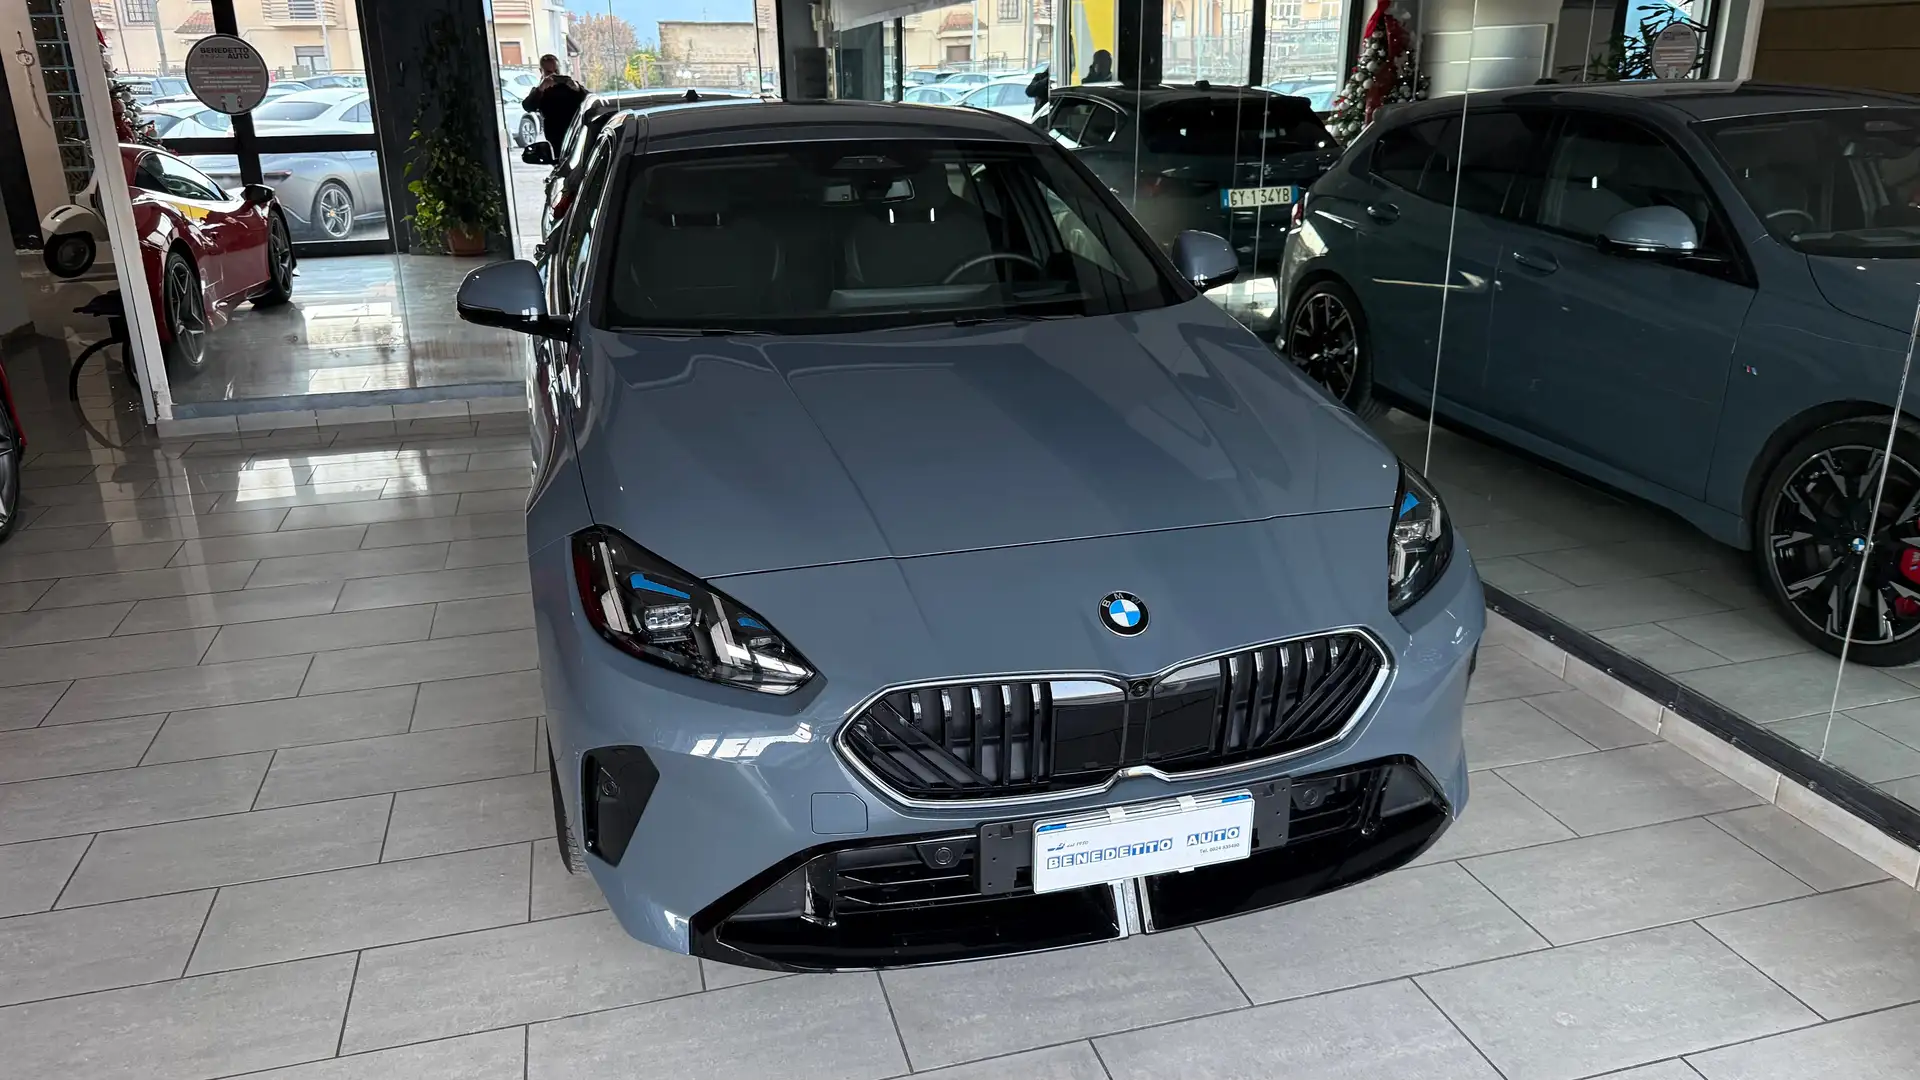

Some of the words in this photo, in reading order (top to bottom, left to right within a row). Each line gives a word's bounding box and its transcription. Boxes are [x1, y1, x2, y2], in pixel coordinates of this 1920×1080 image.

[1101, 592, 1141, 608] BMW
[1046, 838, 1173, 870] BENEDETTO
[1186, 826, 1240, 847] AUTO
